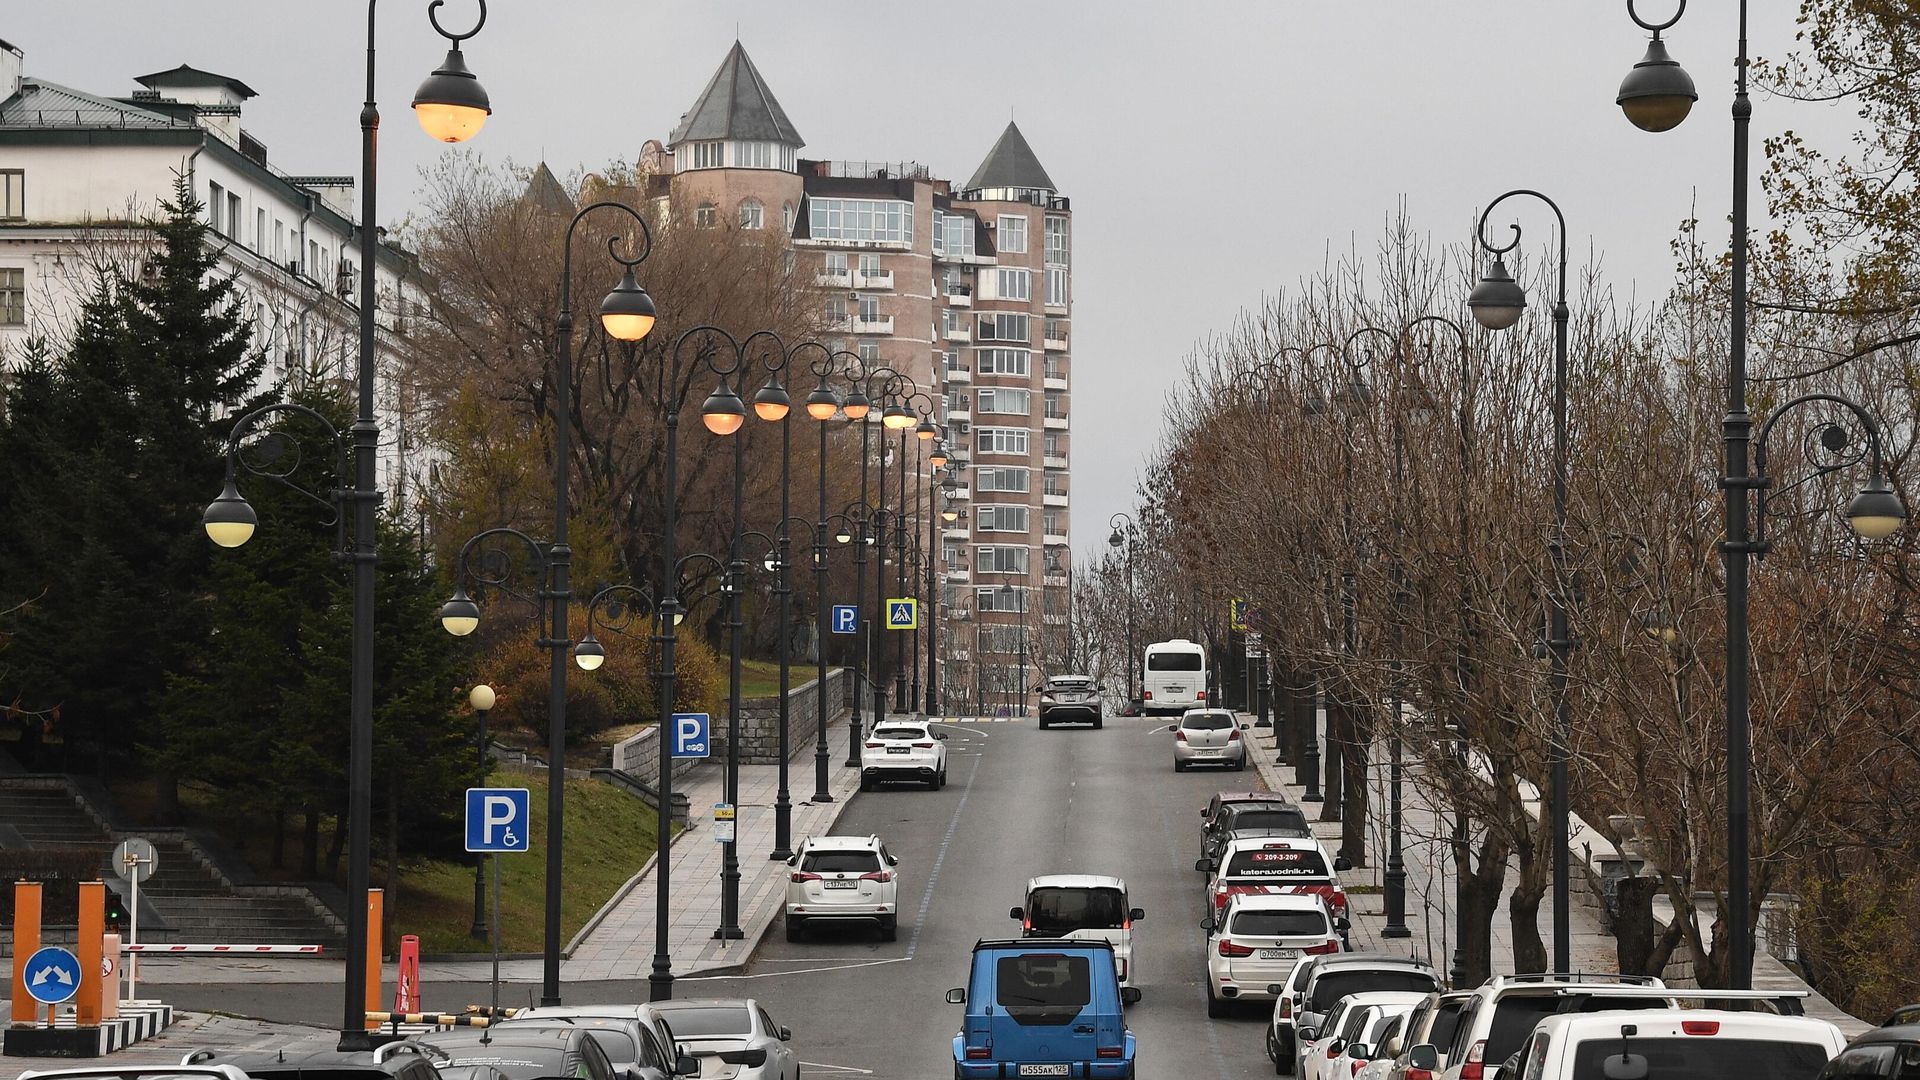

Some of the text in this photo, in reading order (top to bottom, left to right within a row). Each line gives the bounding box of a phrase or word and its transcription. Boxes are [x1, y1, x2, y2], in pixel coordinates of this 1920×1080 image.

[840, 609, 855, 630] P
[678, 719, 701, 752] P
[484, 796, 516, 844] P
